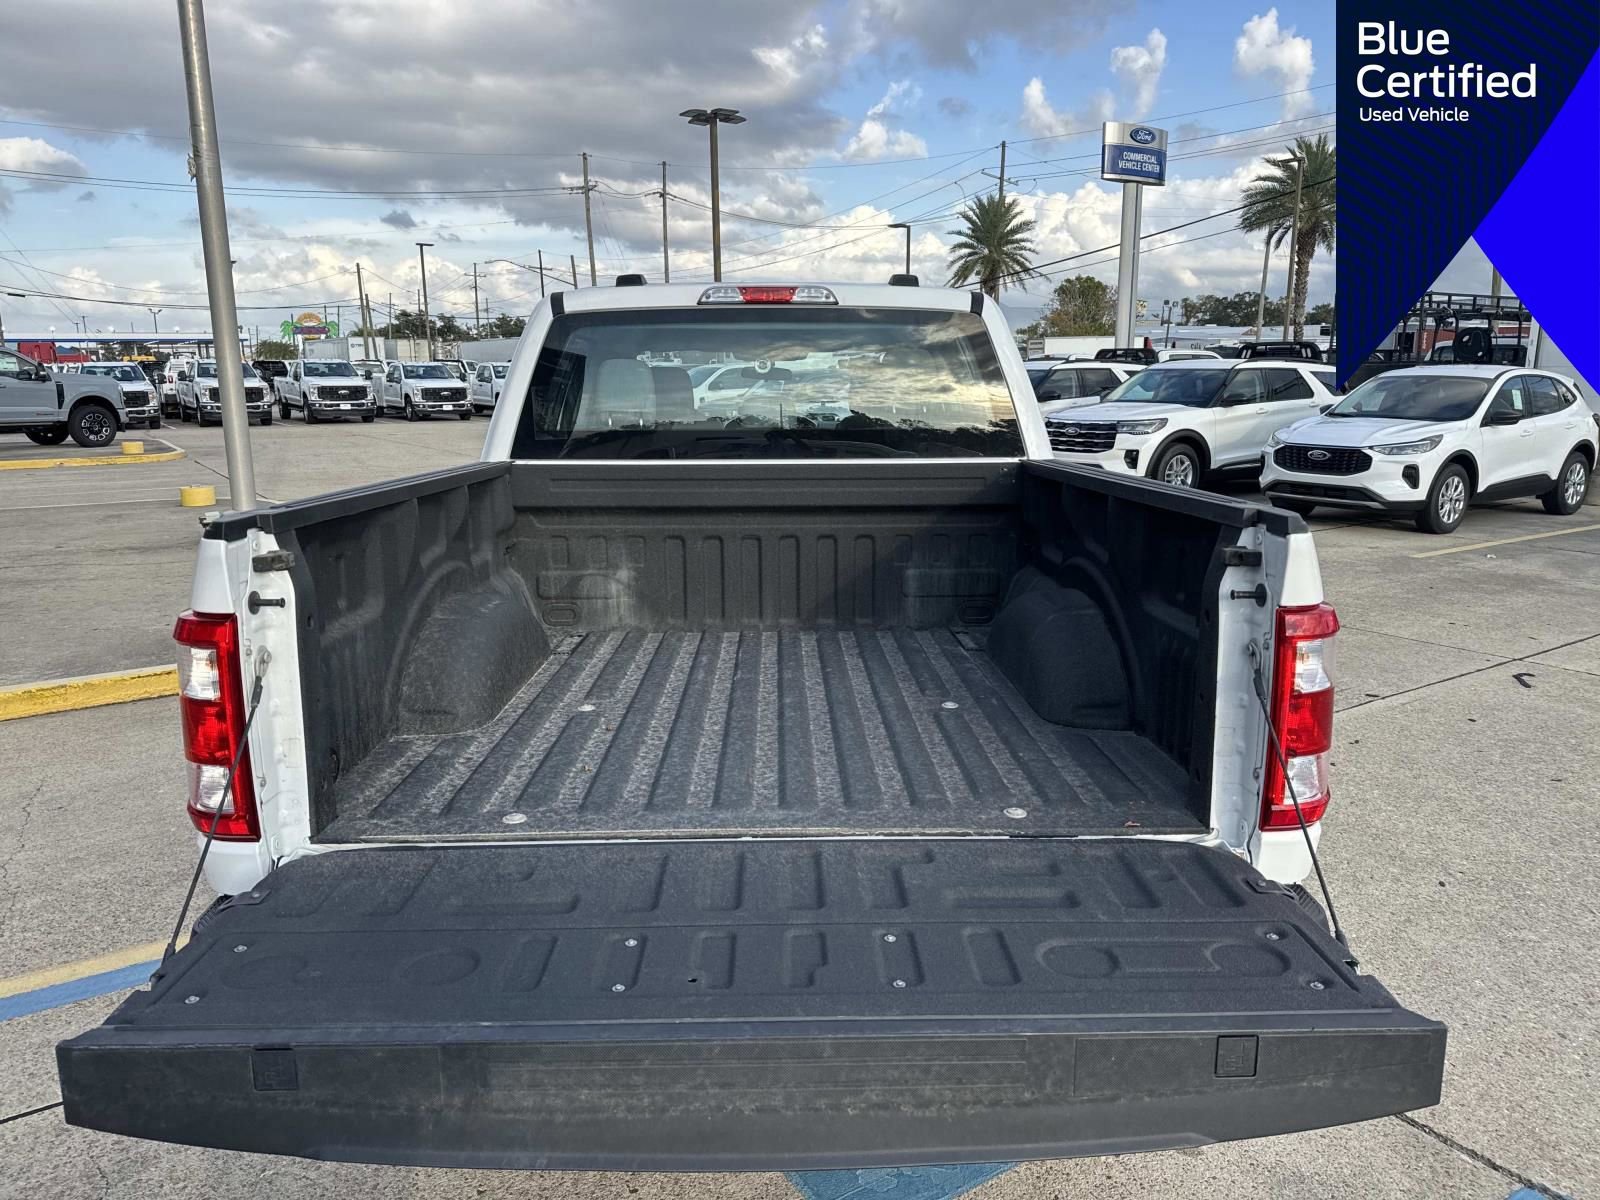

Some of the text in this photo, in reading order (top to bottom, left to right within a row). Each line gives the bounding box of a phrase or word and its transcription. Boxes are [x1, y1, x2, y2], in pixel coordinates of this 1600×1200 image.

[1123, 152, 1158, 163] COMMERCIAL
[1118, 160, 1161, 173] VEHICLE CENTER
